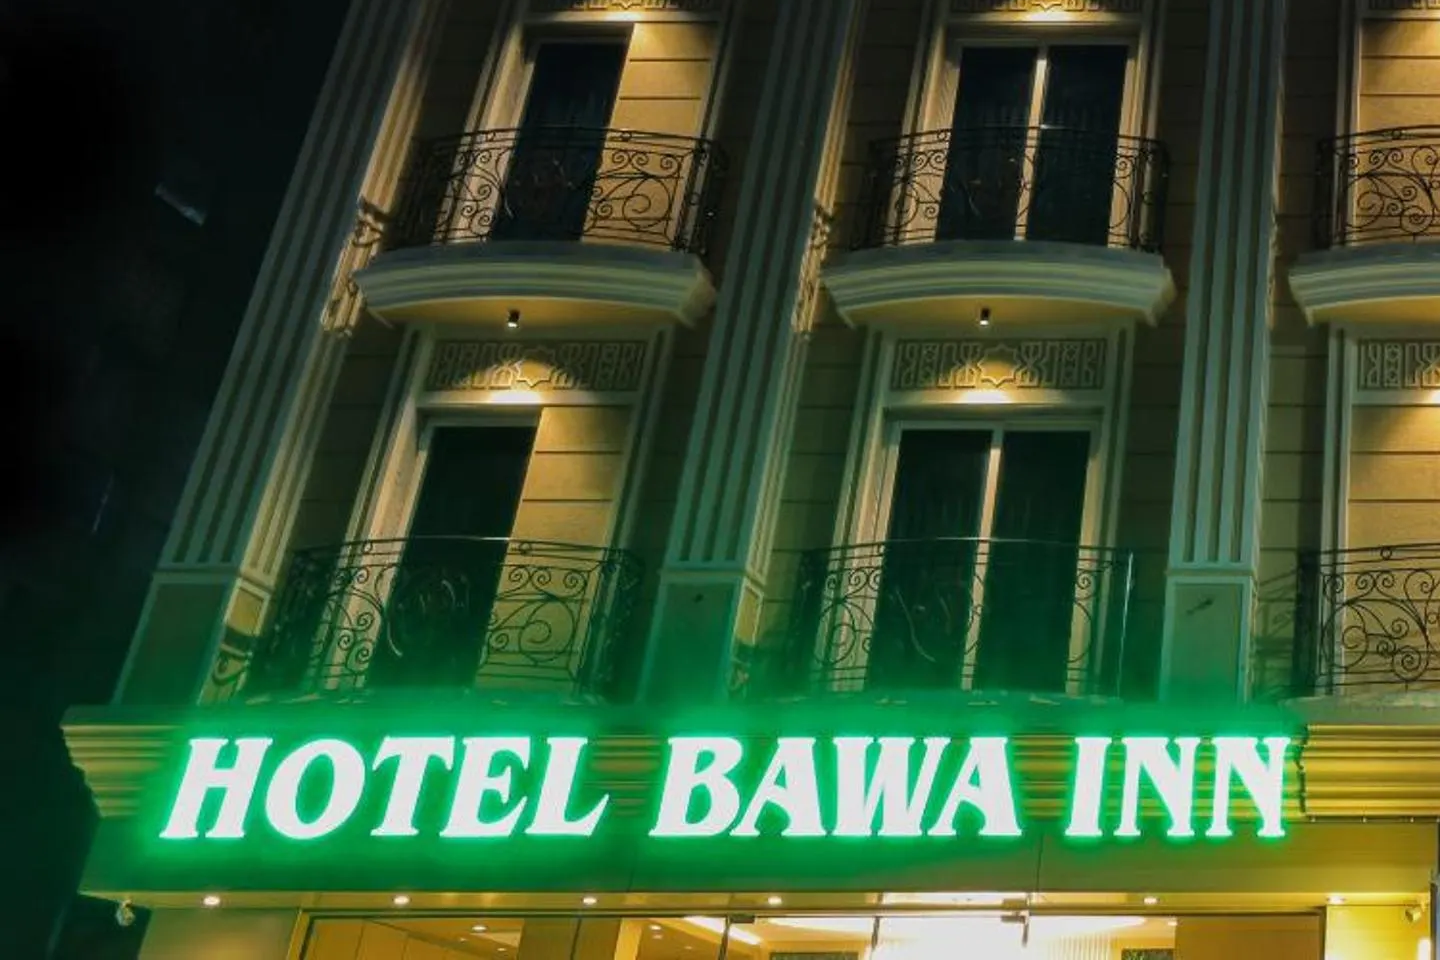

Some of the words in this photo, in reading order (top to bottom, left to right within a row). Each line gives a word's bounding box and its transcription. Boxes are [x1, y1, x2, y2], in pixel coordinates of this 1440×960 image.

[159, 736, 609, 839] HOTEL
[648, 735, 1022, 837] BAWA
[1065, 736, 1291, 837] INN
